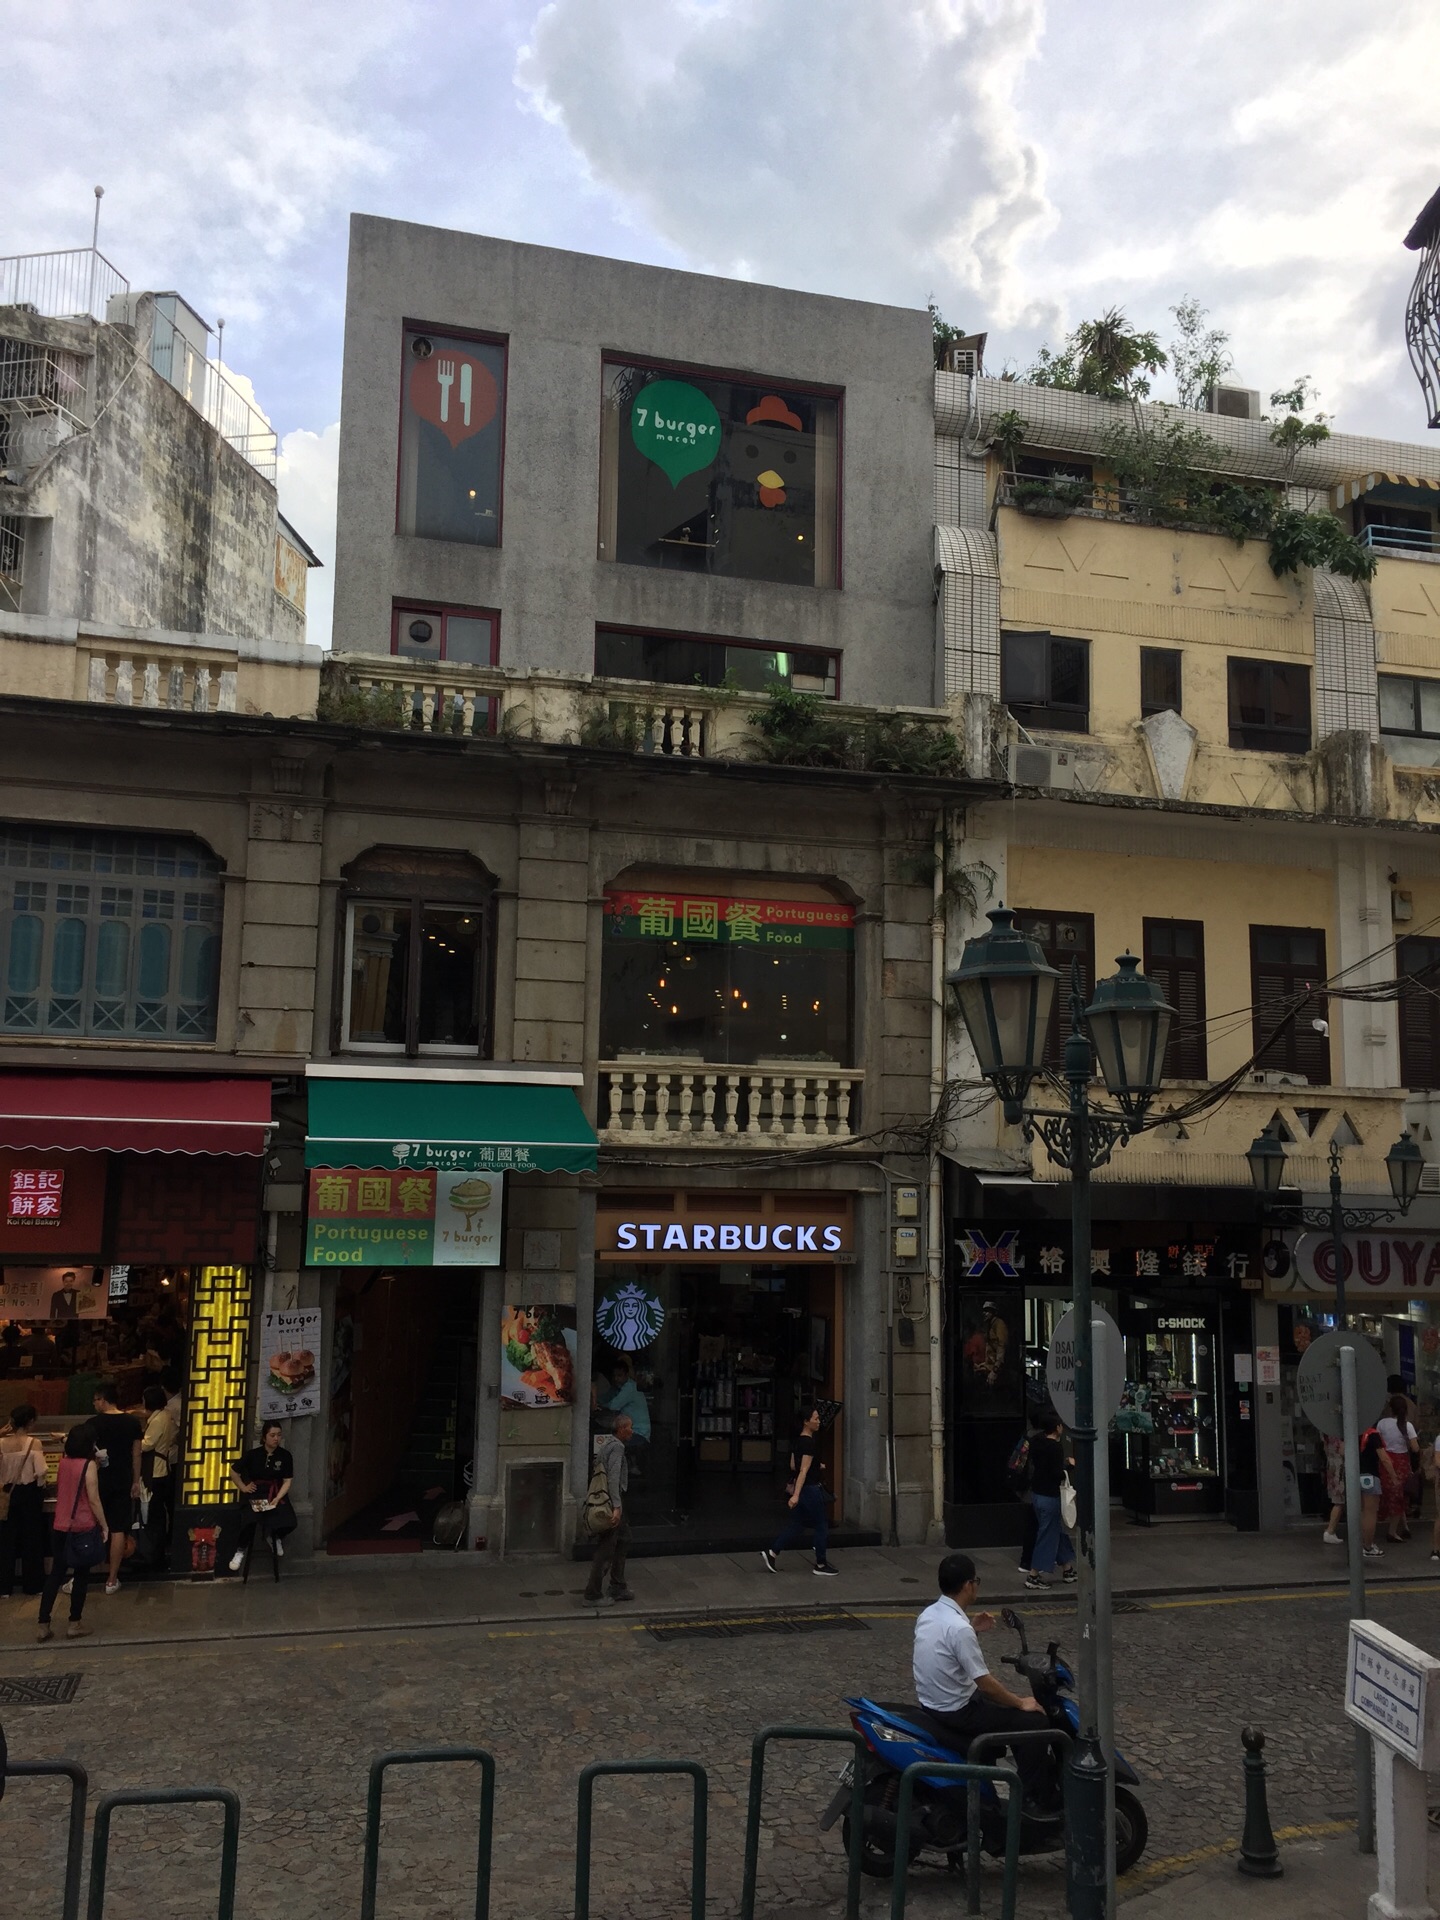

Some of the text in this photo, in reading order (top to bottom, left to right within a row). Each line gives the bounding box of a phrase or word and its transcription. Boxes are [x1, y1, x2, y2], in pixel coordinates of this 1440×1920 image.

[637, 408, 716, 438] 7 burger
[656, 434, 696, 445] macau
[637, 897, 763, 942] 葡國餐
[766, 906, 849, 922] Portuguese
[766, 931, 802, 944] Food
[411, 1143, 472, 1161] 7 burger
[479, 1147, 530, 1162] 葡國餐
[13, 1171, 61, 1190] 鉅記
[315, 1176, 432, 1214] 葡國餐
[11, 1195, 59, 1216] 餅家
[6, 1218, 61, 1227] Koi Kei Bakery
[314, 1224, 429, 1243] Portuguese
[442, 1230, 494, 1246] 7 burger
[616, 1222, 842, 1252] STARBUCKS
[313, 1247, 363, 1262] Food
[266, 1315, 318, 1327] 7 burger
[1157, 1317, 1206, 1329] G-SHOCK
[1373, 1690, 1389, 1707] LARGO
